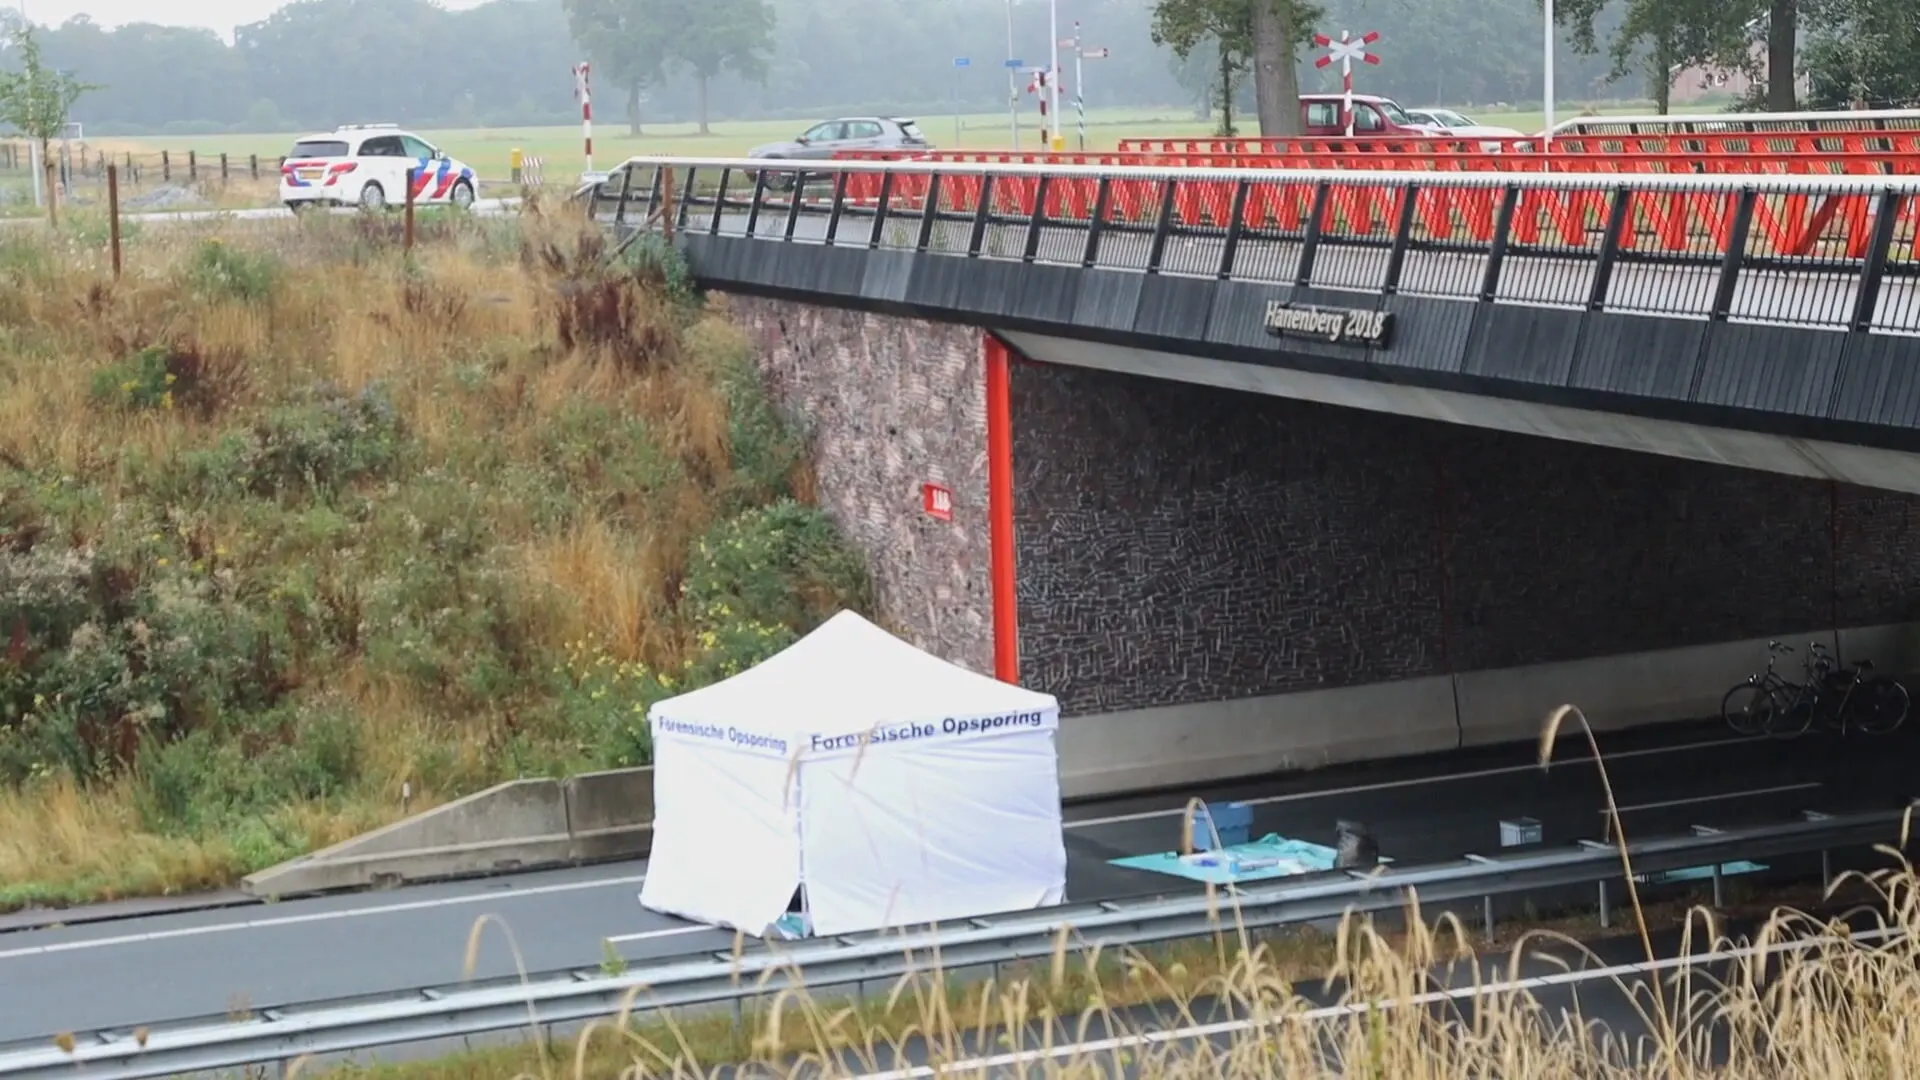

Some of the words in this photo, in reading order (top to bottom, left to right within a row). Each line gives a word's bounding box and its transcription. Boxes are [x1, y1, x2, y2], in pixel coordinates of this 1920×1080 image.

[1265, 300, 1344, 341] Hanenberg
[1344, 310, 1385, 339] 2018
[659, 716, 724, 739] Forensische
[728, 726, 787, 754] Opsporing
[942, 710, 1042, 734] Opsporing
